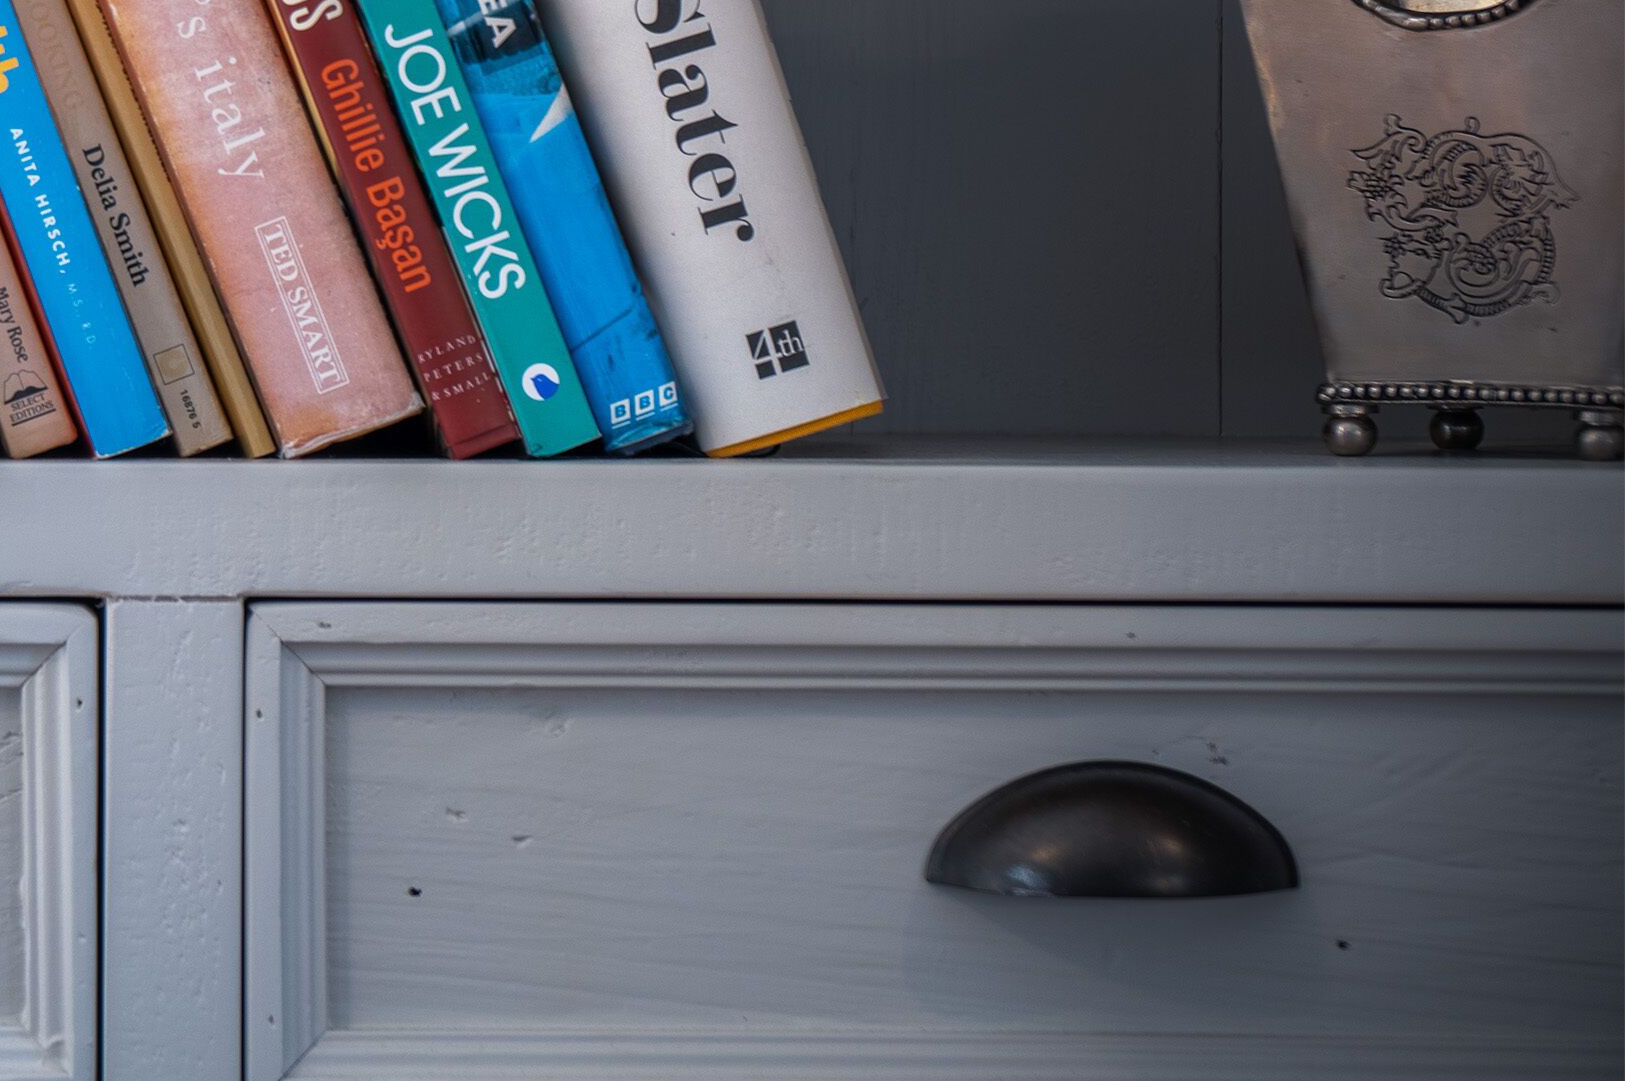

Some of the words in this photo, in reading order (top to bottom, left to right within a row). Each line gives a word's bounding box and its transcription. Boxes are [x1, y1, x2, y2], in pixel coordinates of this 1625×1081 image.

[195, 56, 265, 183] italy
[321, 58, 384, 173] Ghillie
[384, 24, 462, 126] JOE
[427, 123, 526, 300] WICKS
[10, 127, 41, 189] ANITA
[33, 192, 70, 274] HIRSCH,
[82, 144, 119, 213] Delia
[109, 214, 147, 288] Smith
[265, 224, 299, 281] TED
[287, 286, 341, 384] SMART
[8, 326, 28, 363] Rose
[418, 335, 476, 364] RYLAND
[424, 353, 483, 382] PETERS
[745, 320, 810, 380] 4th
[10, 400, 54, 422] EDITIONS
[11, 393, 46, 412] SELECT
[432, 391, 441, 401] &
[443, 372, 489, 397] SMALL
[610, 382, 677, 428] BBC
